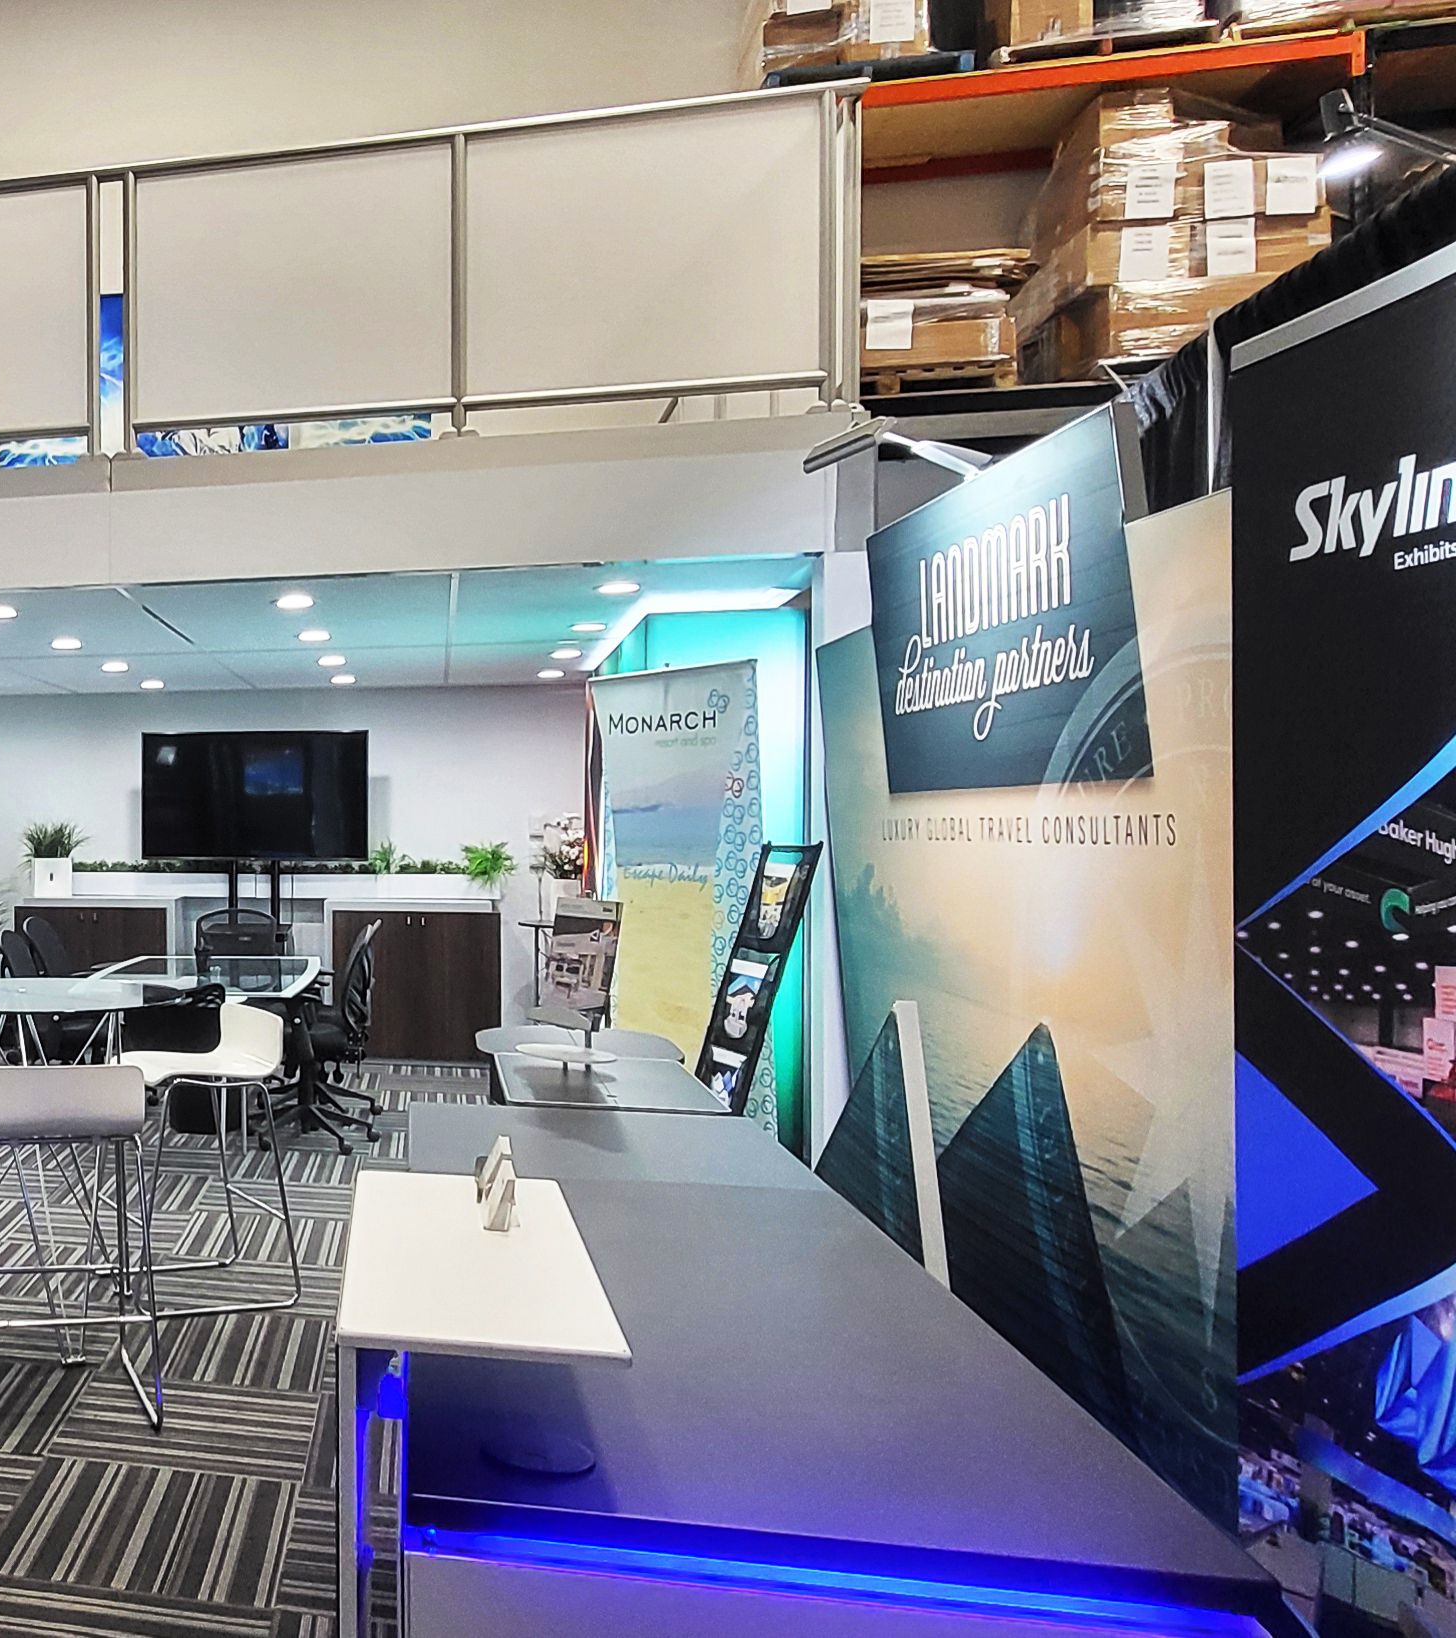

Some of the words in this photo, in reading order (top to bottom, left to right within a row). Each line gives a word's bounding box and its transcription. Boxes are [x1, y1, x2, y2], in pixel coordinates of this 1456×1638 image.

[919, 493, 1071, 649] LANDMARK
[1394, 540, 1456, 570] Exhibits
[895, 634, 988, 716] destination
[973, 624, 1095, 741] partners
[882, 818, 920, 842] LUXURY
[926, 818, 972, 842] GLOBAL
[979, 817, 1033, 844] TRAVEL
[1042, 813, 1177, 847] CONSULTANTS
[624, 867, 664, 887] Escape
[668, 862, 709, 892] Daily
